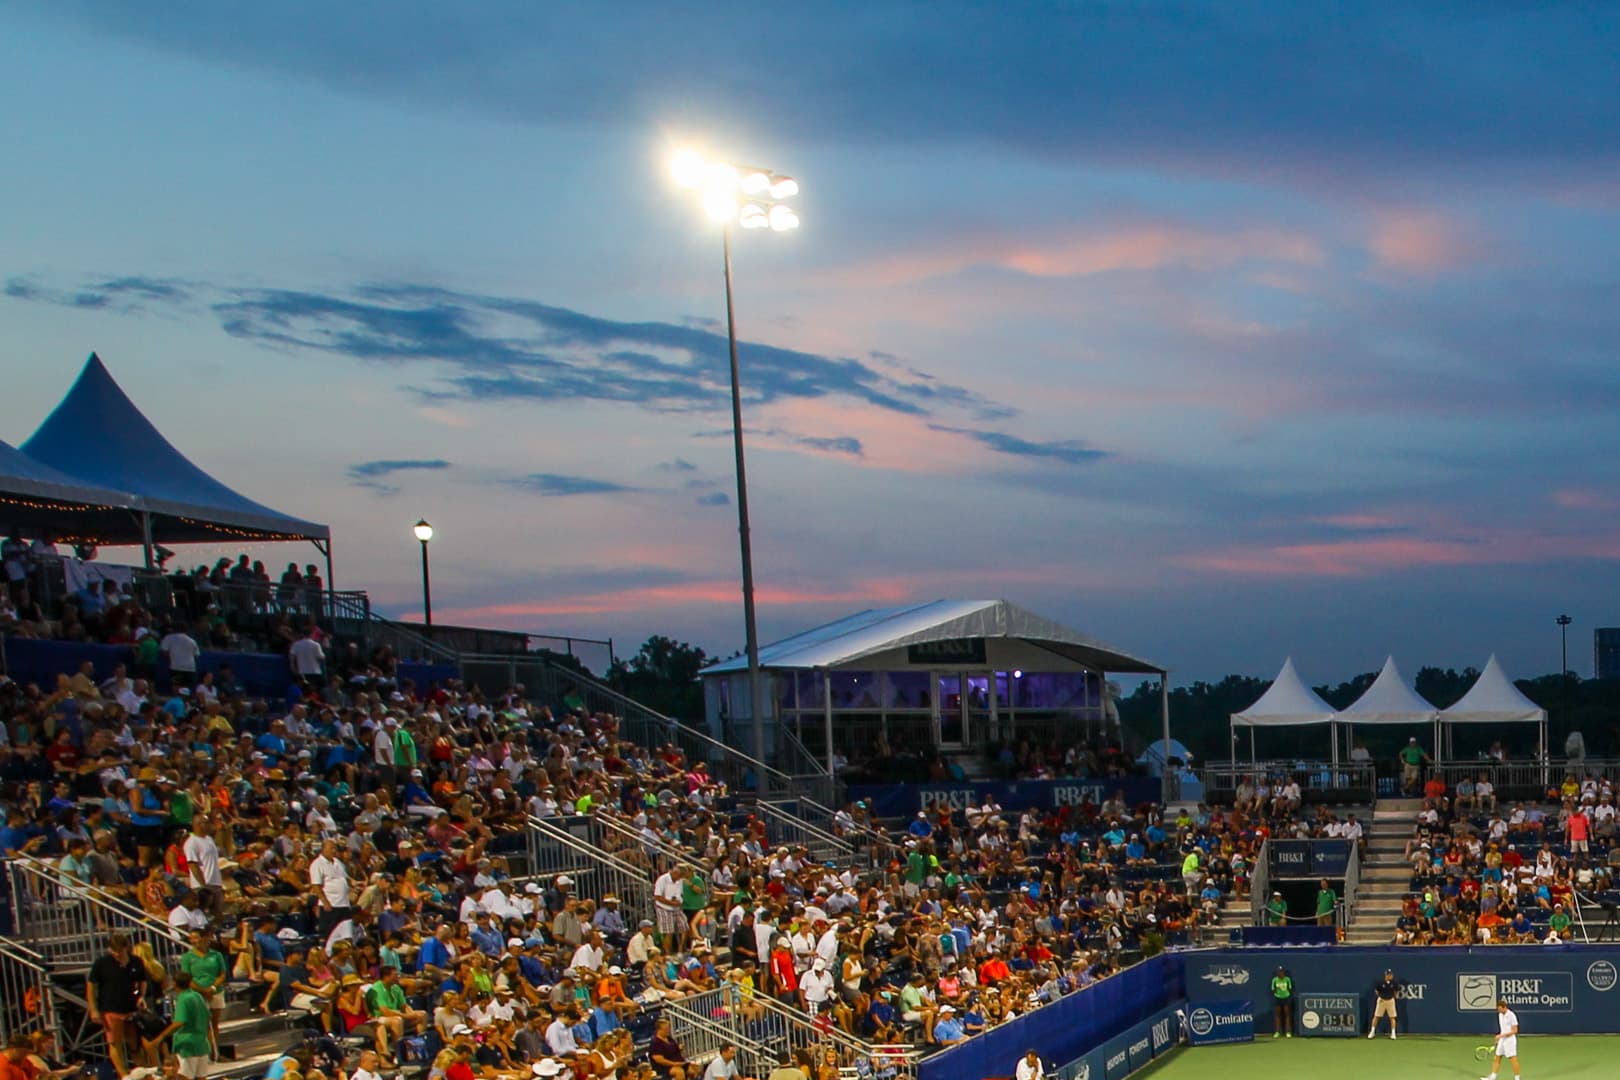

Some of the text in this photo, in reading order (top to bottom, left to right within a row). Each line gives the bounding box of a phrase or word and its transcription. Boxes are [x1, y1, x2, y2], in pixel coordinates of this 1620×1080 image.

[1397, 983, 1427, 1000] B&T
[1500, 979, 1543, 994] BB&T
[1304, 998, 1353, 1009] CITIZEN
[1501, 994, 1569, 1007] Atlanta Open
[1215, 1014, 1253, 1025] Emirates
